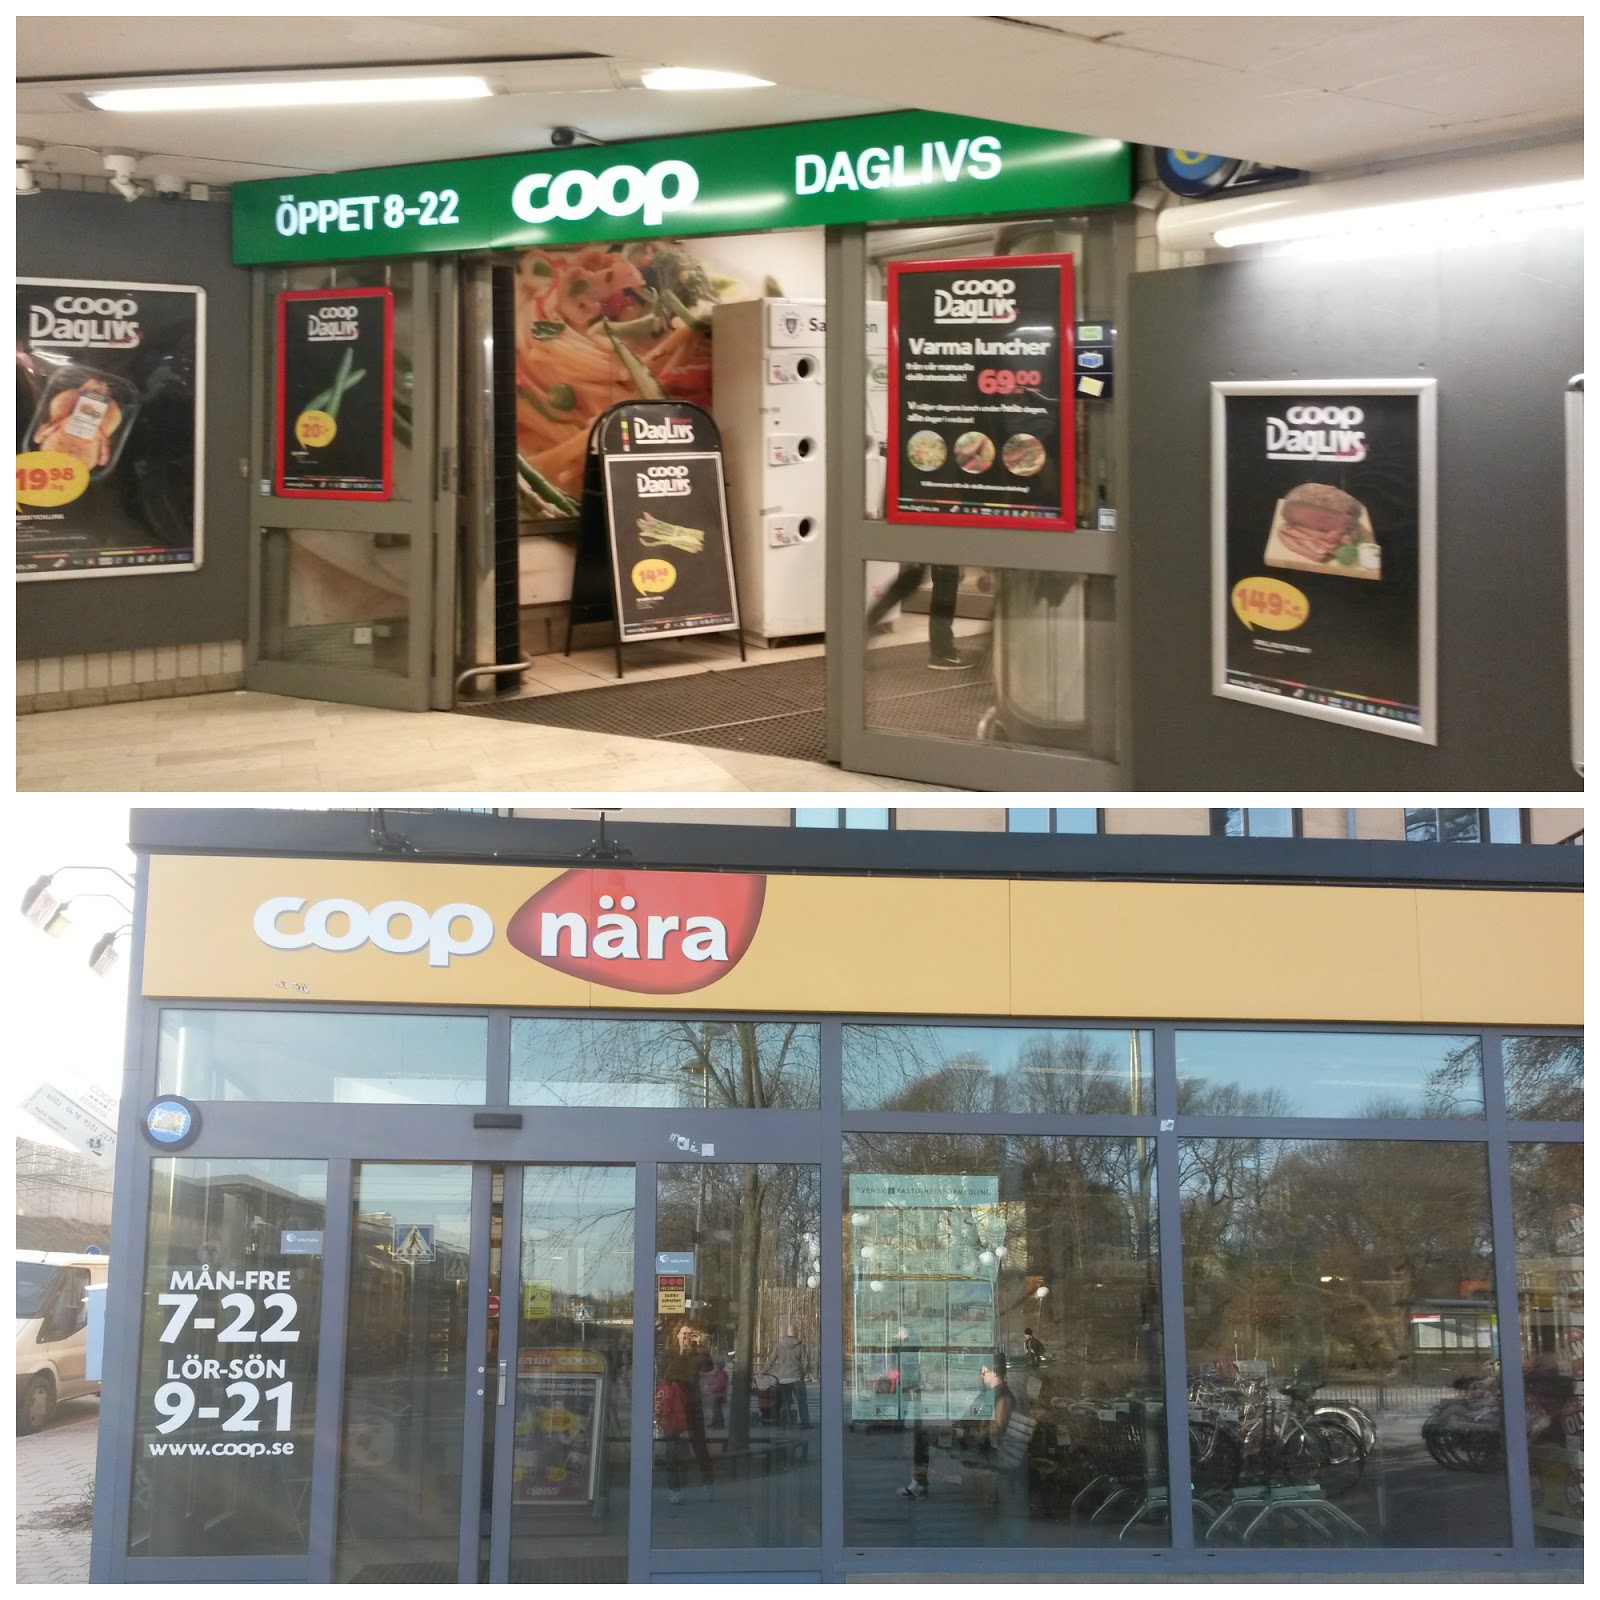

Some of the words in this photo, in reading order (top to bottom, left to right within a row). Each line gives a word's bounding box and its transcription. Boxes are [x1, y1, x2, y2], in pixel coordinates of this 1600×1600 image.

[795, 135, 1003, 196] DAGLIVS
[511, 159, 699, 225] coop
[275, 194, 380, 236] ÖPPET
[383, 189, 460, 229] 8-22
[951, 278, 1016, 298] coop
[54, 296, 139, 319] coop
[319, 305, 359, 321] coop
[908, 337, 973, 356] Varma
[974, 337, 1051, 356] luncher
[1285, 405, 1365, 430] coop
[647, 465, 689, 479] coop
[254, 895, 495, 967] coop
[540, 894, 730, 962] nära
[169, 1263, 291, 1290] MÅN-FRE
[157, 1292, 300, 1344] 7-22
[166, 1353, 286, 1380] LÖR-SÖN
[153, 1381, 294, 1435] 9-21
[148, 1442, 295, 1458] www.coop.se
